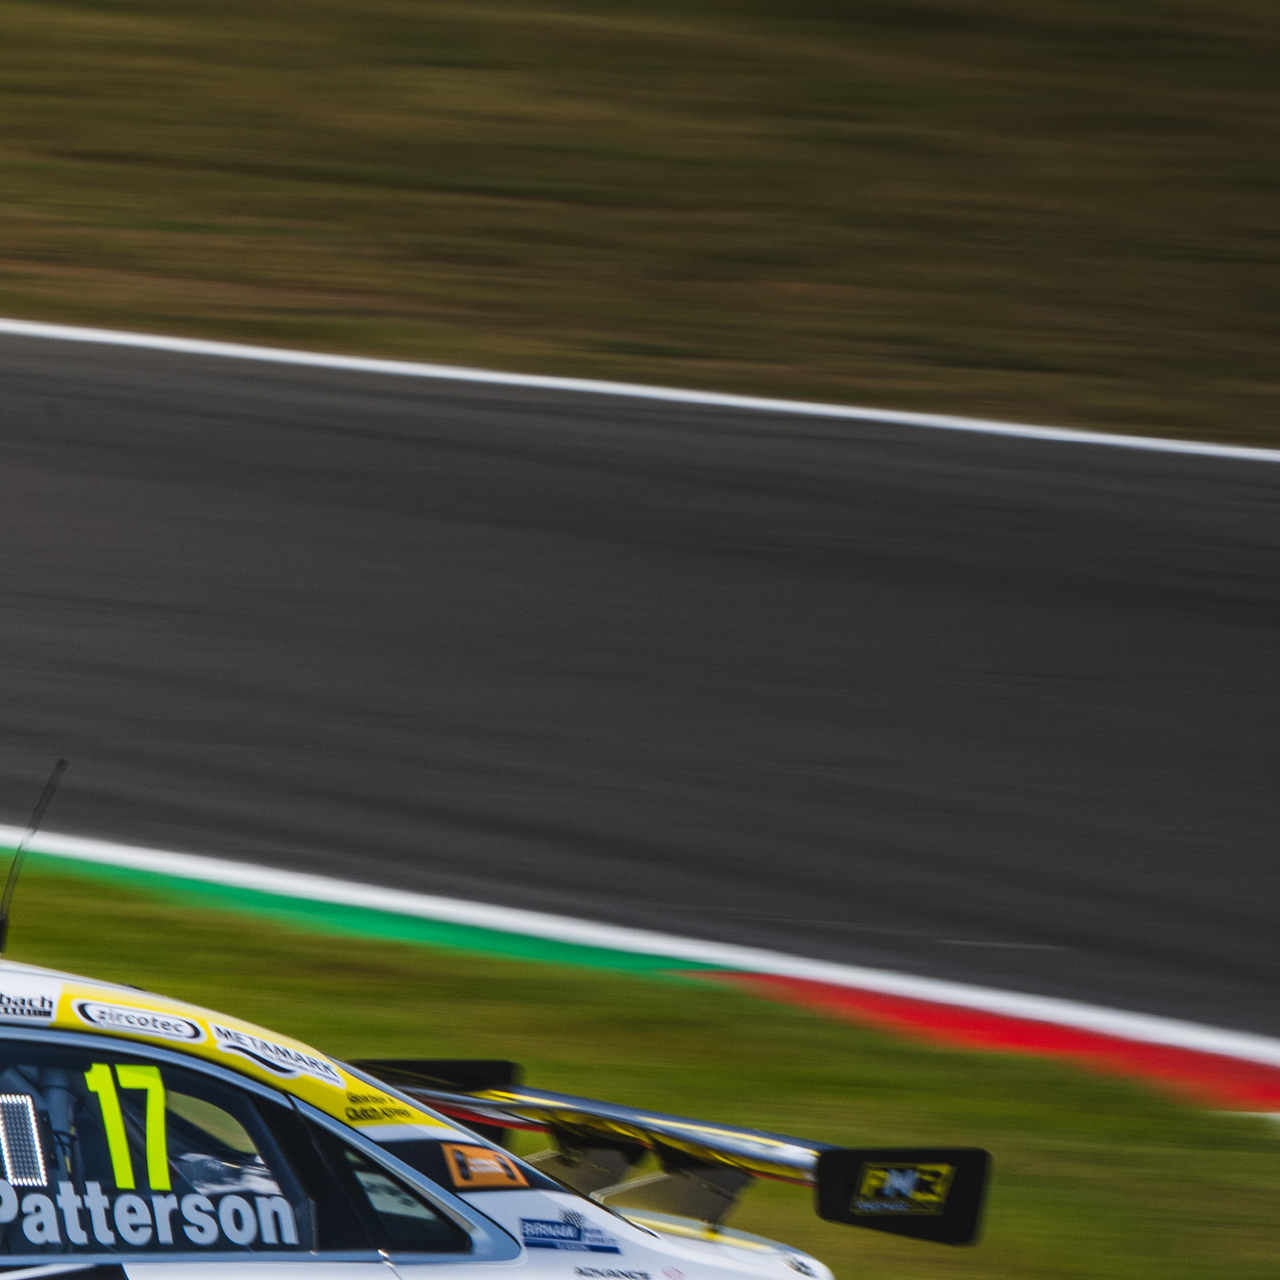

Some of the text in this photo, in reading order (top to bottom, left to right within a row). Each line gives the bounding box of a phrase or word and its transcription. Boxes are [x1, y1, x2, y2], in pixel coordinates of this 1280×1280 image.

[97, 1008, 186, 1034] zircotec
[213, 1024, 339, 1079] METAMARK
[84, 1063, 171, 1190] 17
